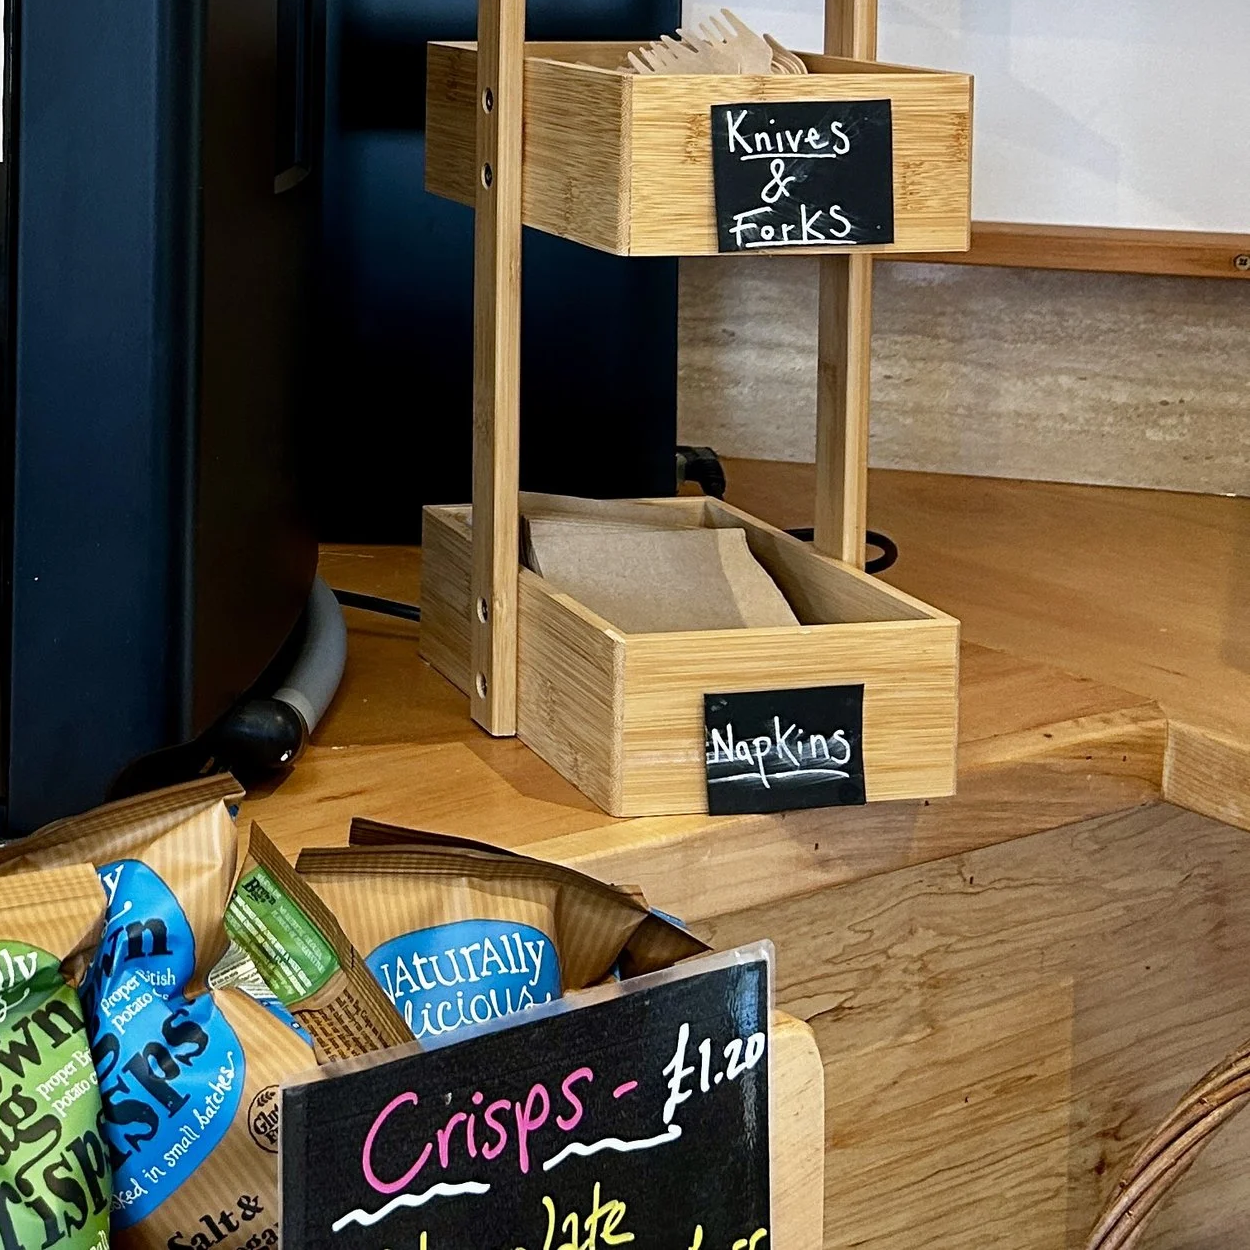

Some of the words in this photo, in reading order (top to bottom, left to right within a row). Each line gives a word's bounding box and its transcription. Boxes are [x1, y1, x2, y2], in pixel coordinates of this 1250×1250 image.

[726, 110, 850, 155] Knives
[761, 158, 796, 203] &
[711, 716, 850, 789] Napkins
[111, 993, 154, 1035] potato
[35, 1056, 77, 1100] proper
[51, 1079, 91, 1118] potato
[143, 1165, 166, 1184] in
[164, 1124, 200, 1168] small
[193, 1051, 236, 1130] batches
[361, 1066, 593, 1194] Crisps
[662, 1022, 766, 1126] £1.20
[237, 1194, 264, 1221] &
